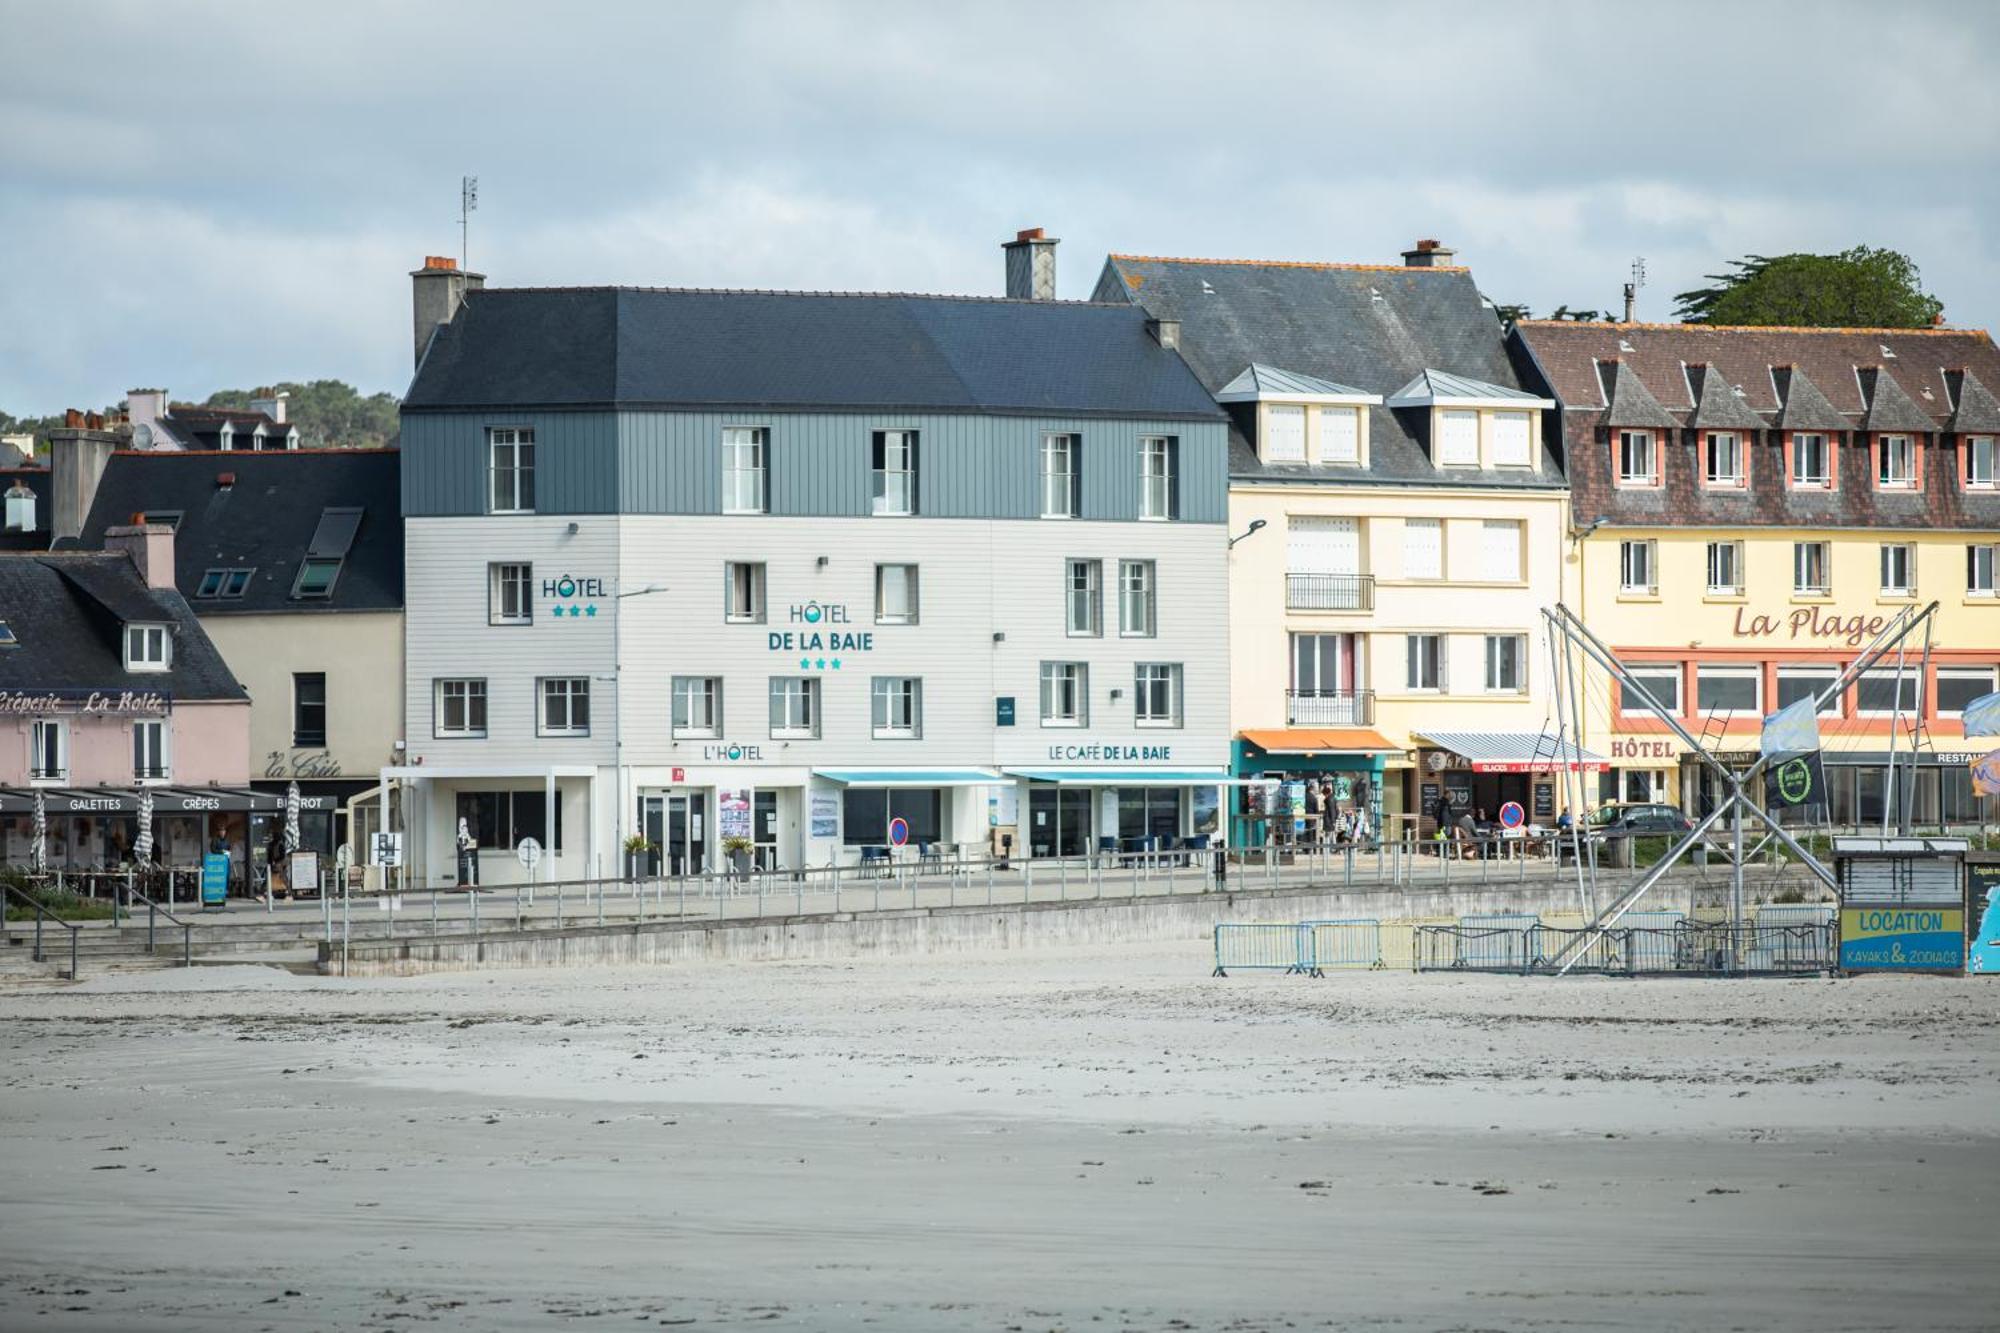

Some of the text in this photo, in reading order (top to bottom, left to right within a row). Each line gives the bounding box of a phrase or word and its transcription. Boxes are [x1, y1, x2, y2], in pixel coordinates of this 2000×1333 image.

[543, 574, 607, 598] HÔTEL
[790, 600, 851, 624] HÔTEL
[1733, 606, 1891, 647] La Plage
[768, 632, 873, 651] DE LA BAIE
[84, 692, 109, 711] La
[118, 691, 163, 711] Bolée
[704, 743, 764, 760] L'HÔTEL
[1049, 742, 1170, 760] LE CAFÉ DE LA BAIE
[1611, 738, 1675, 758] HÔTEL
[1695, 752, 1751, 763] REAURANT
[70, 800, 121, 811] GALETTES
[182, 797, 219, 810] CRÊPES
[276, 798, 322, 809] BIROT
[1860, 911, 1943, 932] LOCATION
[1847, 951, 1889, 964] KAYAKS
[1891, 942, 1905, 963] &
